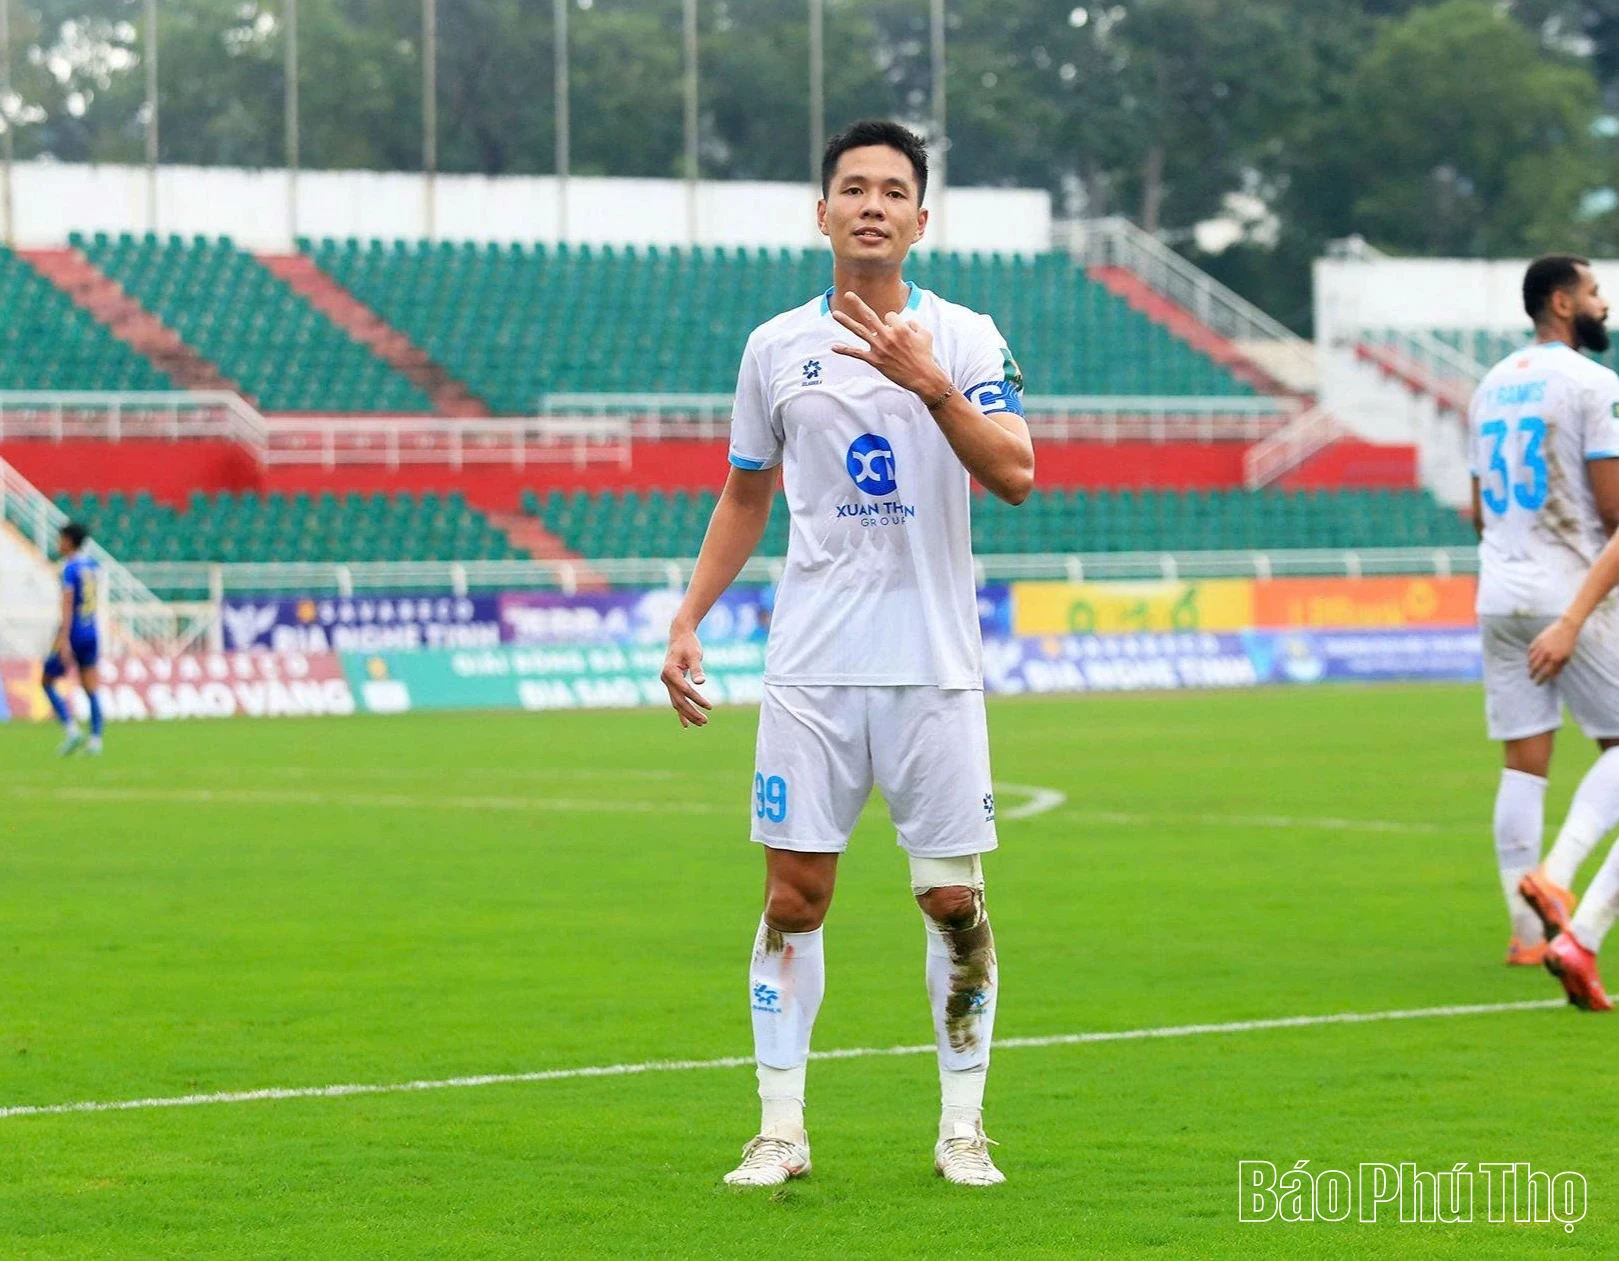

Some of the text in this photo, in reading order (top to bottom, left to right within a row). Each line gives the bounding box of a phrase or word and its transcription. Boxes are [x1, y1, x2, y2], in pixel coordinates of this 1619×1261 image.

[971, 385, 1007, 412] C
[1480, 416, 1549, 516] 33
[836, 503, 878, 518] XUAN
[753, 770, 787, 824] 99
